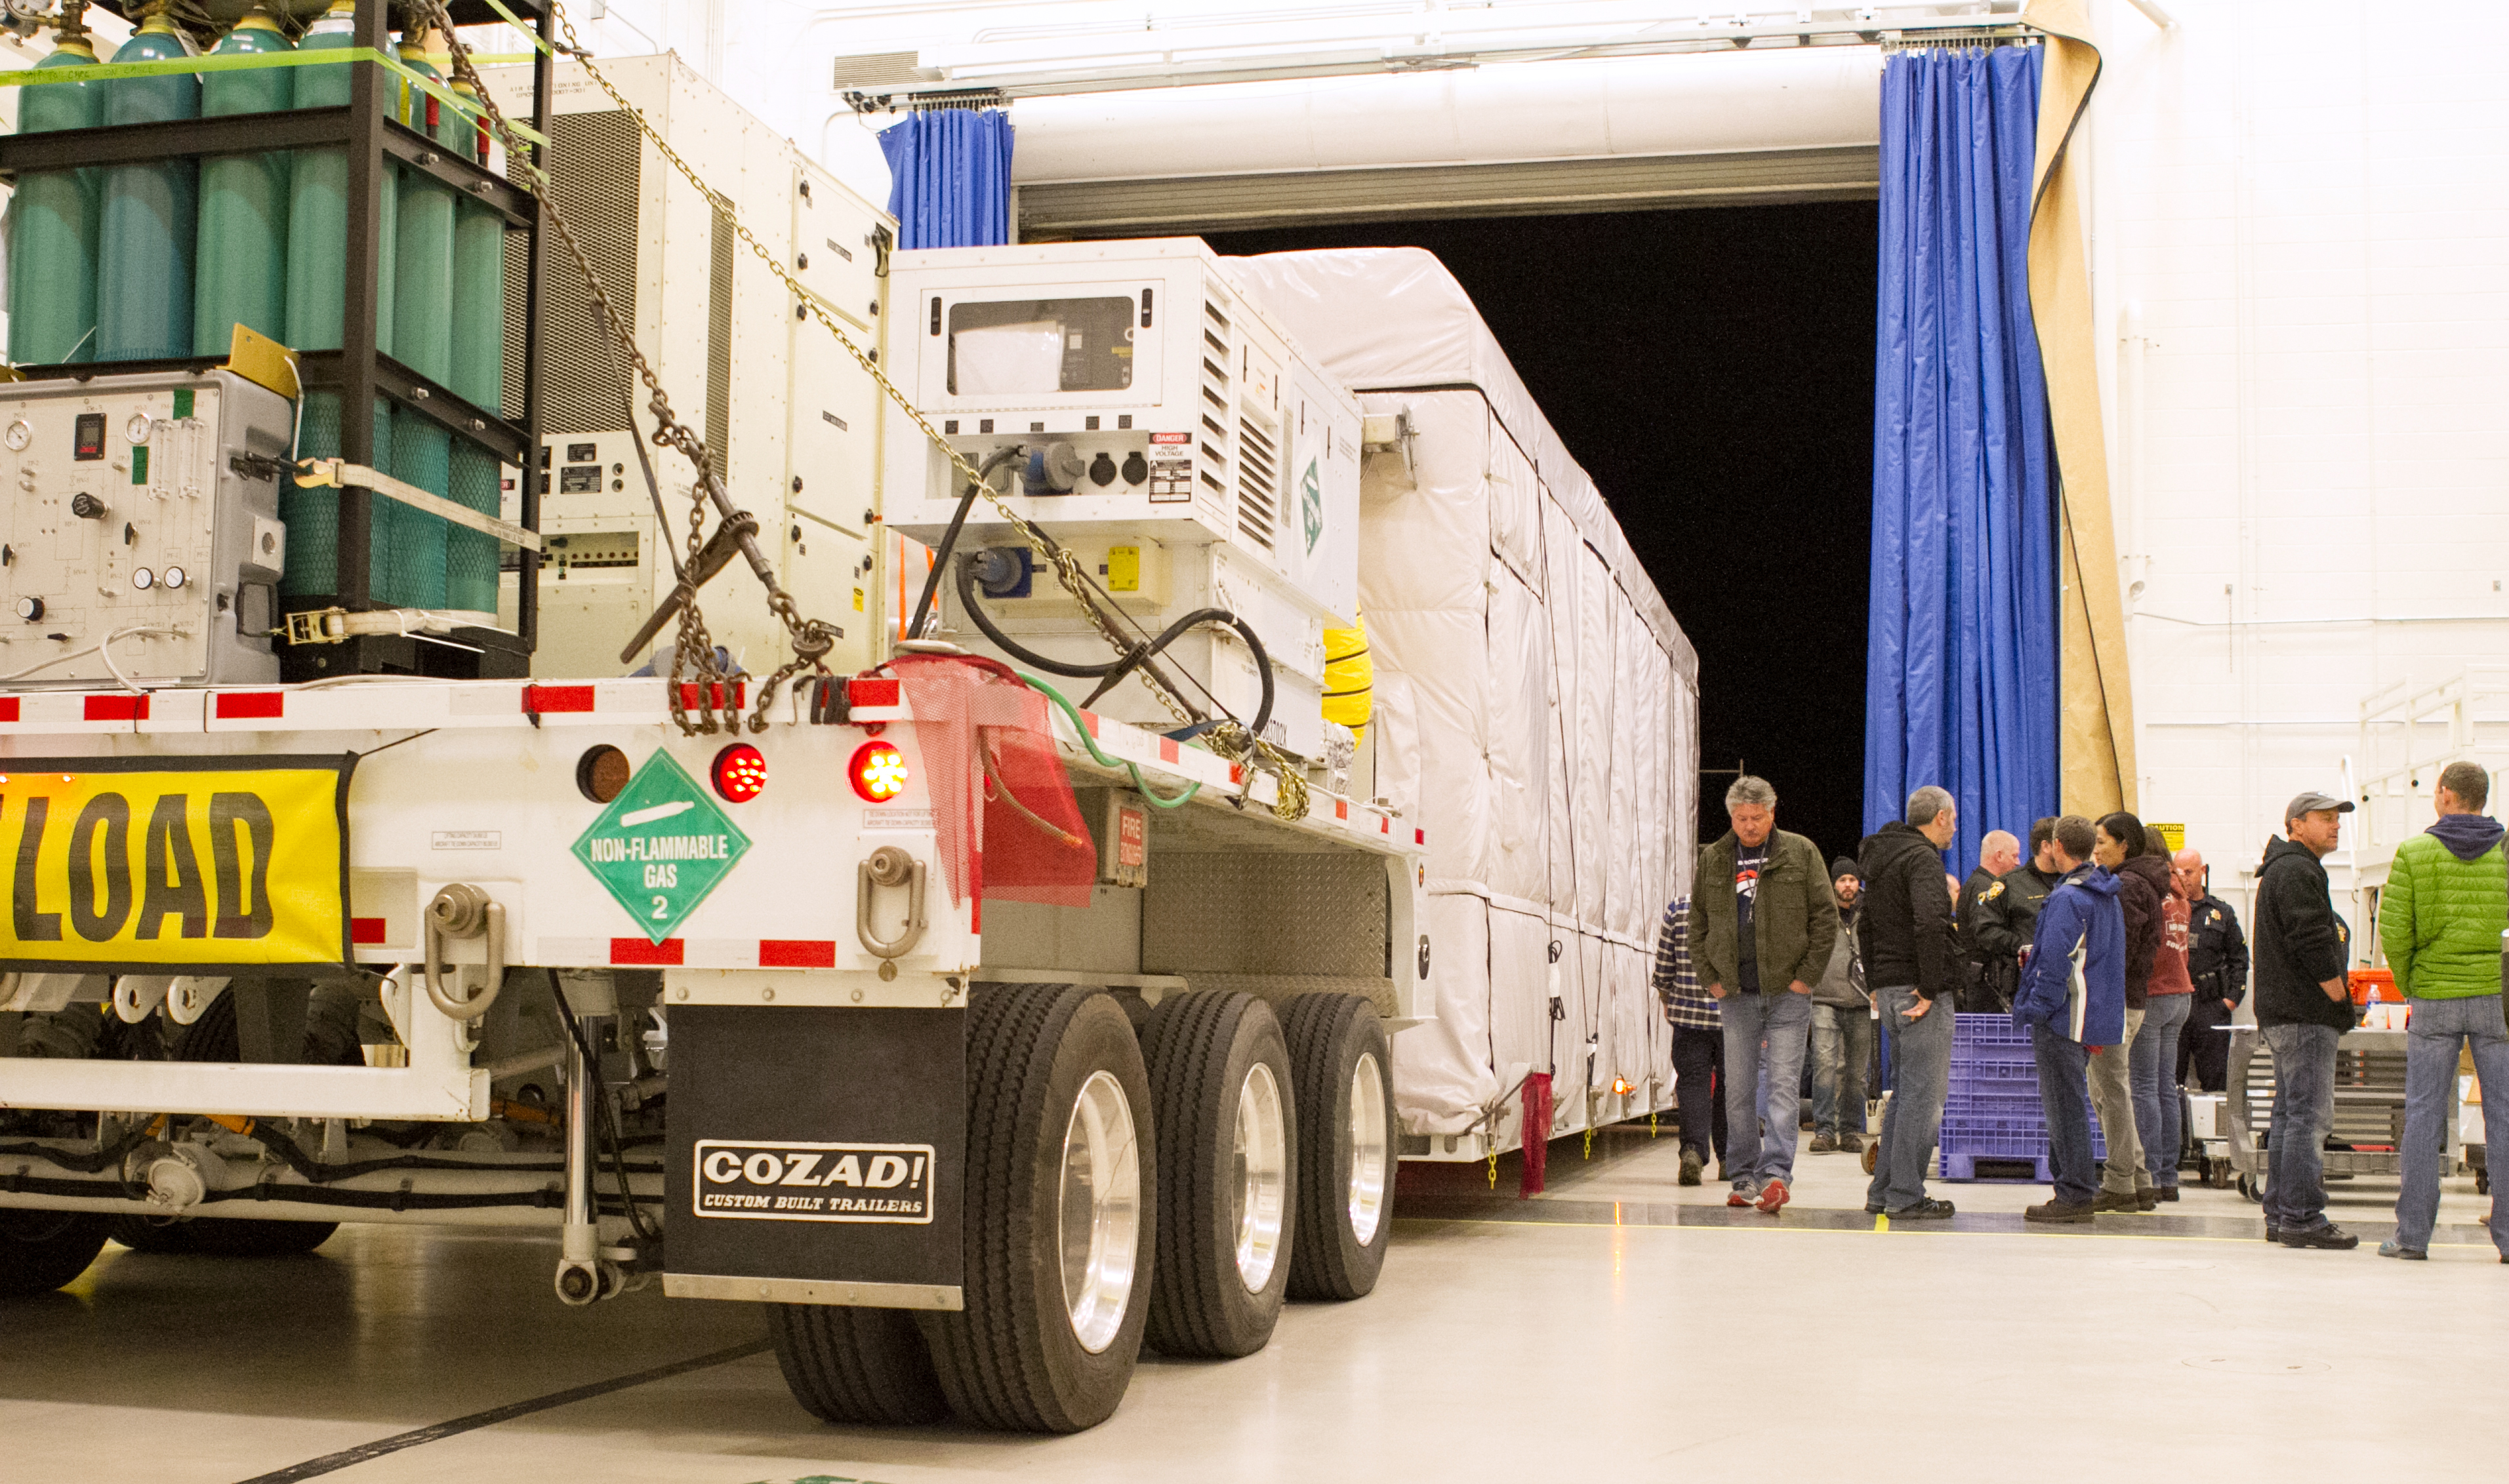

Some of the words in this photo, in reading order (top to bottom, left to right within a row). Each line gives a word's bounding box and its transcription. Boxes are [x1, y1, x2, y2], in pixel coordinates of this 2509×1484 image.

[1122, 815, 1141, 839] FIRE
[591, 835, 729, 862] NON-FLAMMABLE
[12, 792, 275, 942] LOAD
[644, 864, 678, 888] GAS
[651, 895, 668, 919] 2
[703, 1151, 926, 1189] COZAD!
[704, 1193, 771, 1209] CUSTOM
[774, 1196, 824, 1211] BUILT
[830, 1198, 922, 1213] TRAILERS
